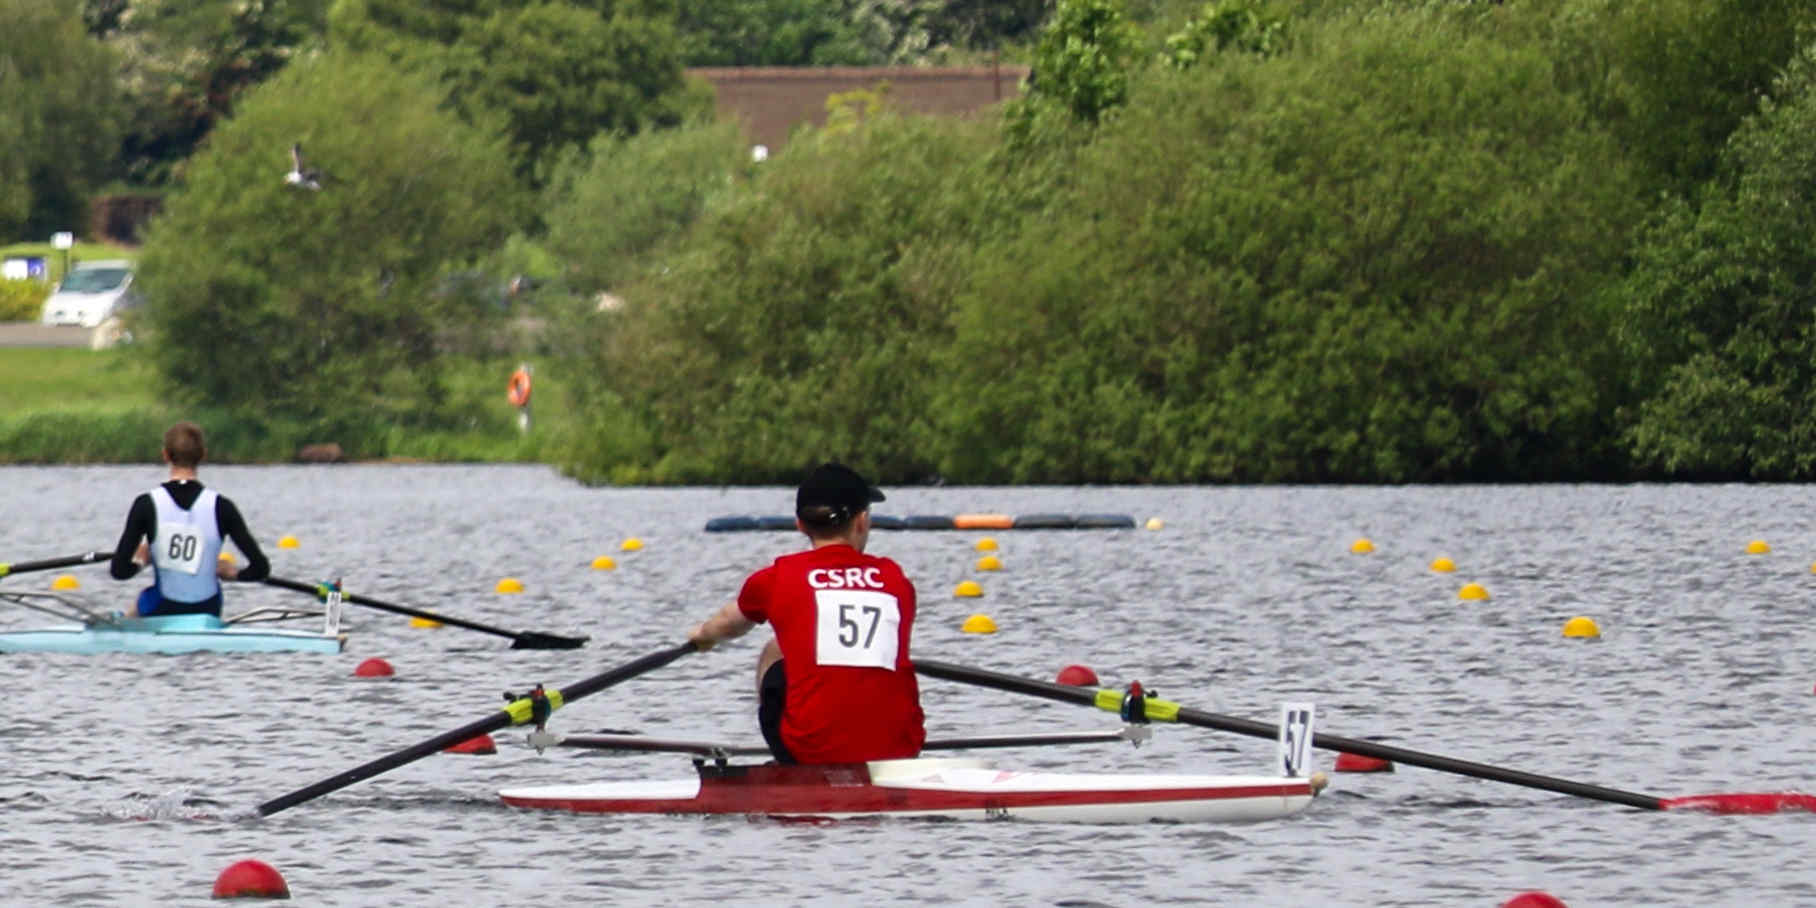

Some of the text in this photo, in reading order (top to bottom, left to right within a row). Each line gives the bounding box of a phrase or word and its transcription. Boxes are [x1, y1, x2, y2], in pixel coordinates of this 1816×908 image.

[169, 534, 197, 562] 60
[808, 567, 884, 588] CSRC
[838, 604, 881, 649] 57
[1285, 710, 1310, 777] 57
